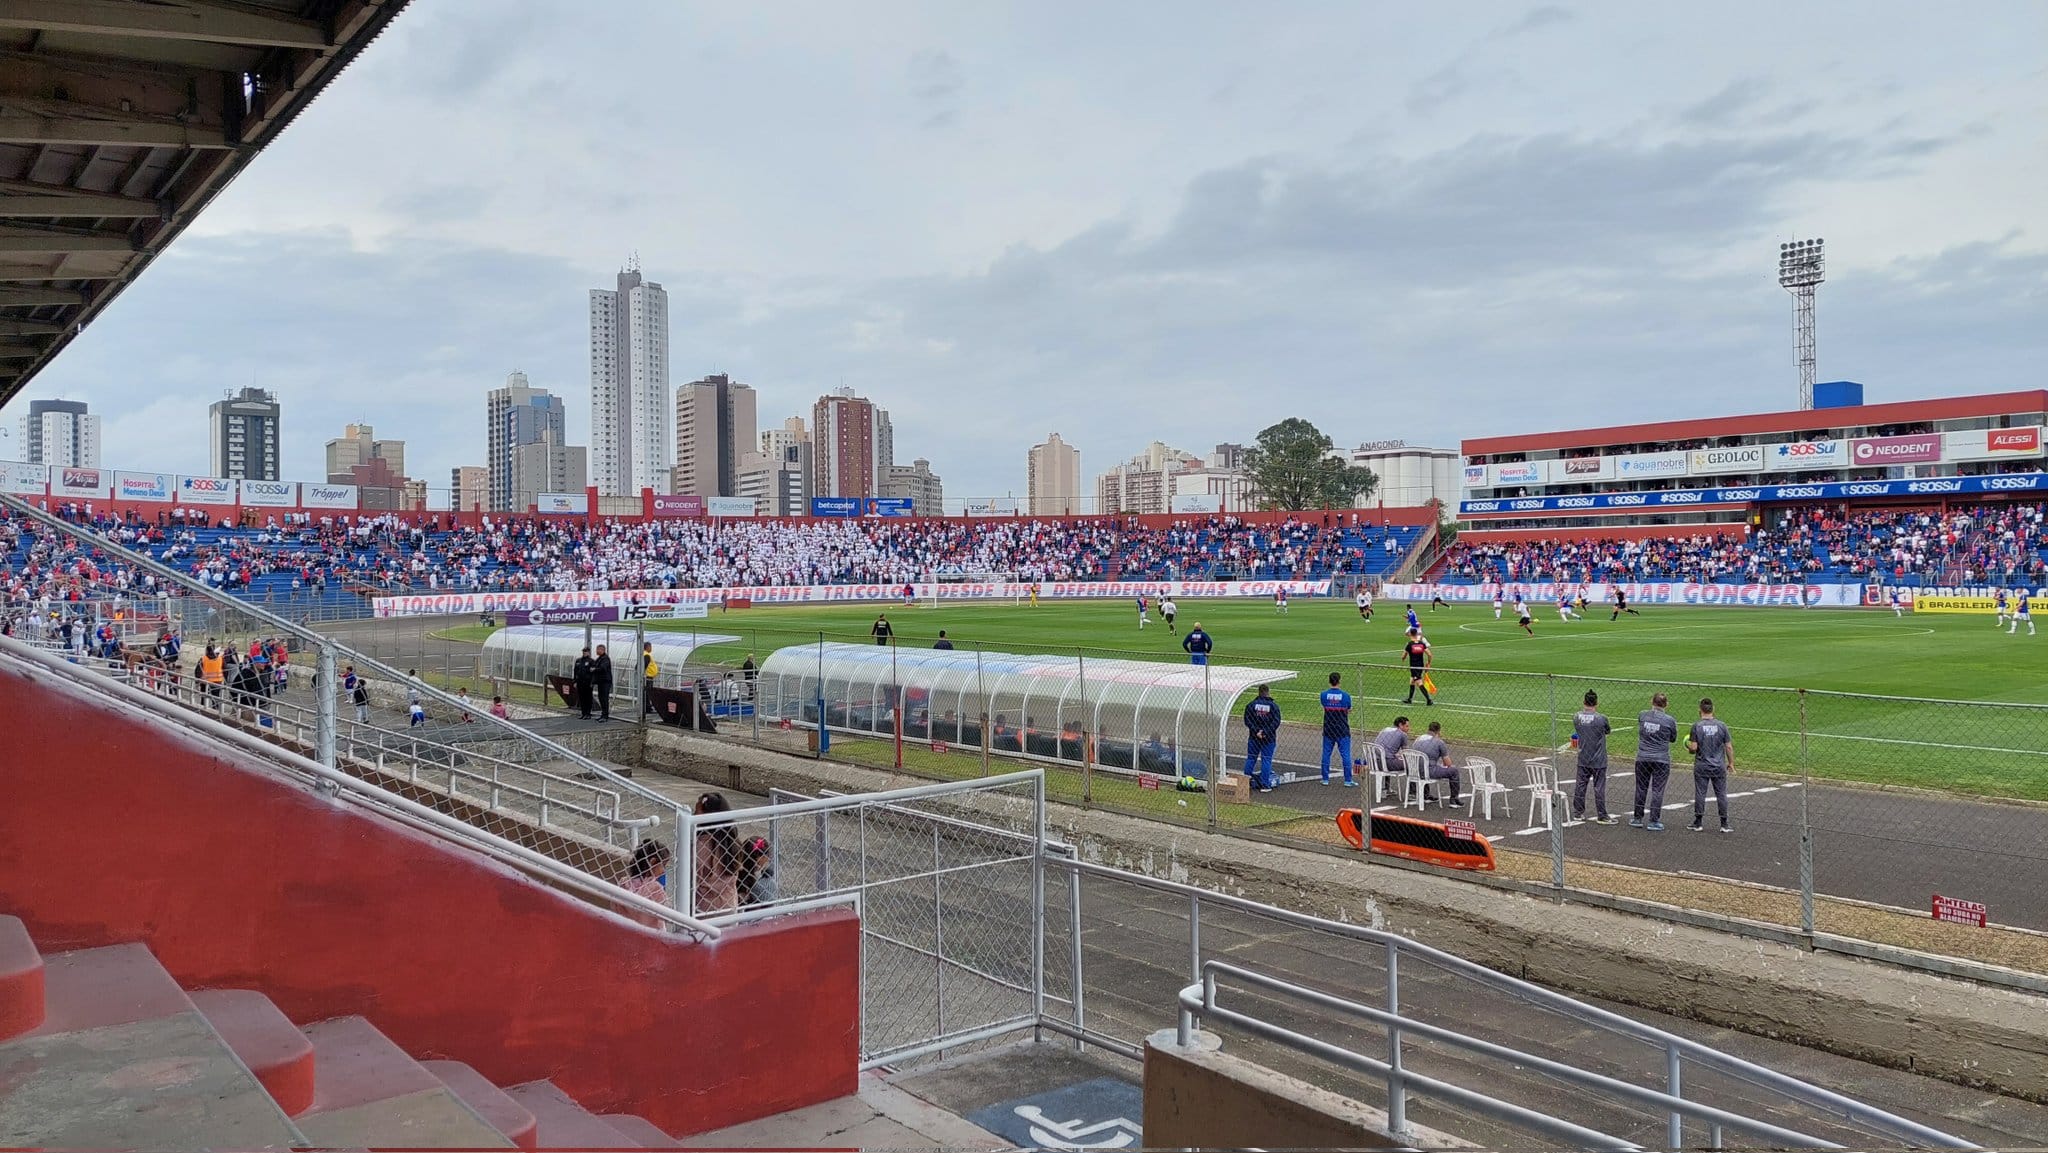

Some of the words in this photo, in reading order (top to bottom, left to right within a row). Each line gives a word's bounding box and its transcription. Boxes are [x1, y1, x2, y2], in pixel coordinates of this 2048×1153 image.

[1993, 434, 2033, 445] ALESSI
[1790, 442, 1836, 456] SOSSul
[1876, 443, 1932, 455] NEODENT
[1708, 450, 1759, 465] GEOLOC
[123, 479, 155, 489] HOSPITAL
[192, 479, 228, 491] SOSSul
[254, 483, 289, 495] SOSSul
[1918, 480, 1962, 492] SOSSul
[1991, 477, 2038, 489] SOSSul
[149, 489, 165, 497] Deus
[1725, 489, 1762, 500] SOSSul
[1785, 486, 1824, 497] SOSSul
[1849, 484, 1890, 495] SOSSul
[1614, 495, 1647, 505] SOSSul
[1669, 492, 1703, 502] SOSSul
[936, 583, 994, 598] DESDE
[1053, 582, 1172, 597] DEFENDENDO
[1180, 582, 1228, 596] SUAS
[1408, 583, 1470, 602] DIGO
[402, 595, 475, 614] TORCIDA
[823, 585, 914, 600] TRICOLO
[546, 611, 595, 623] NEODENT
[624, 605, 648, 620] HS
